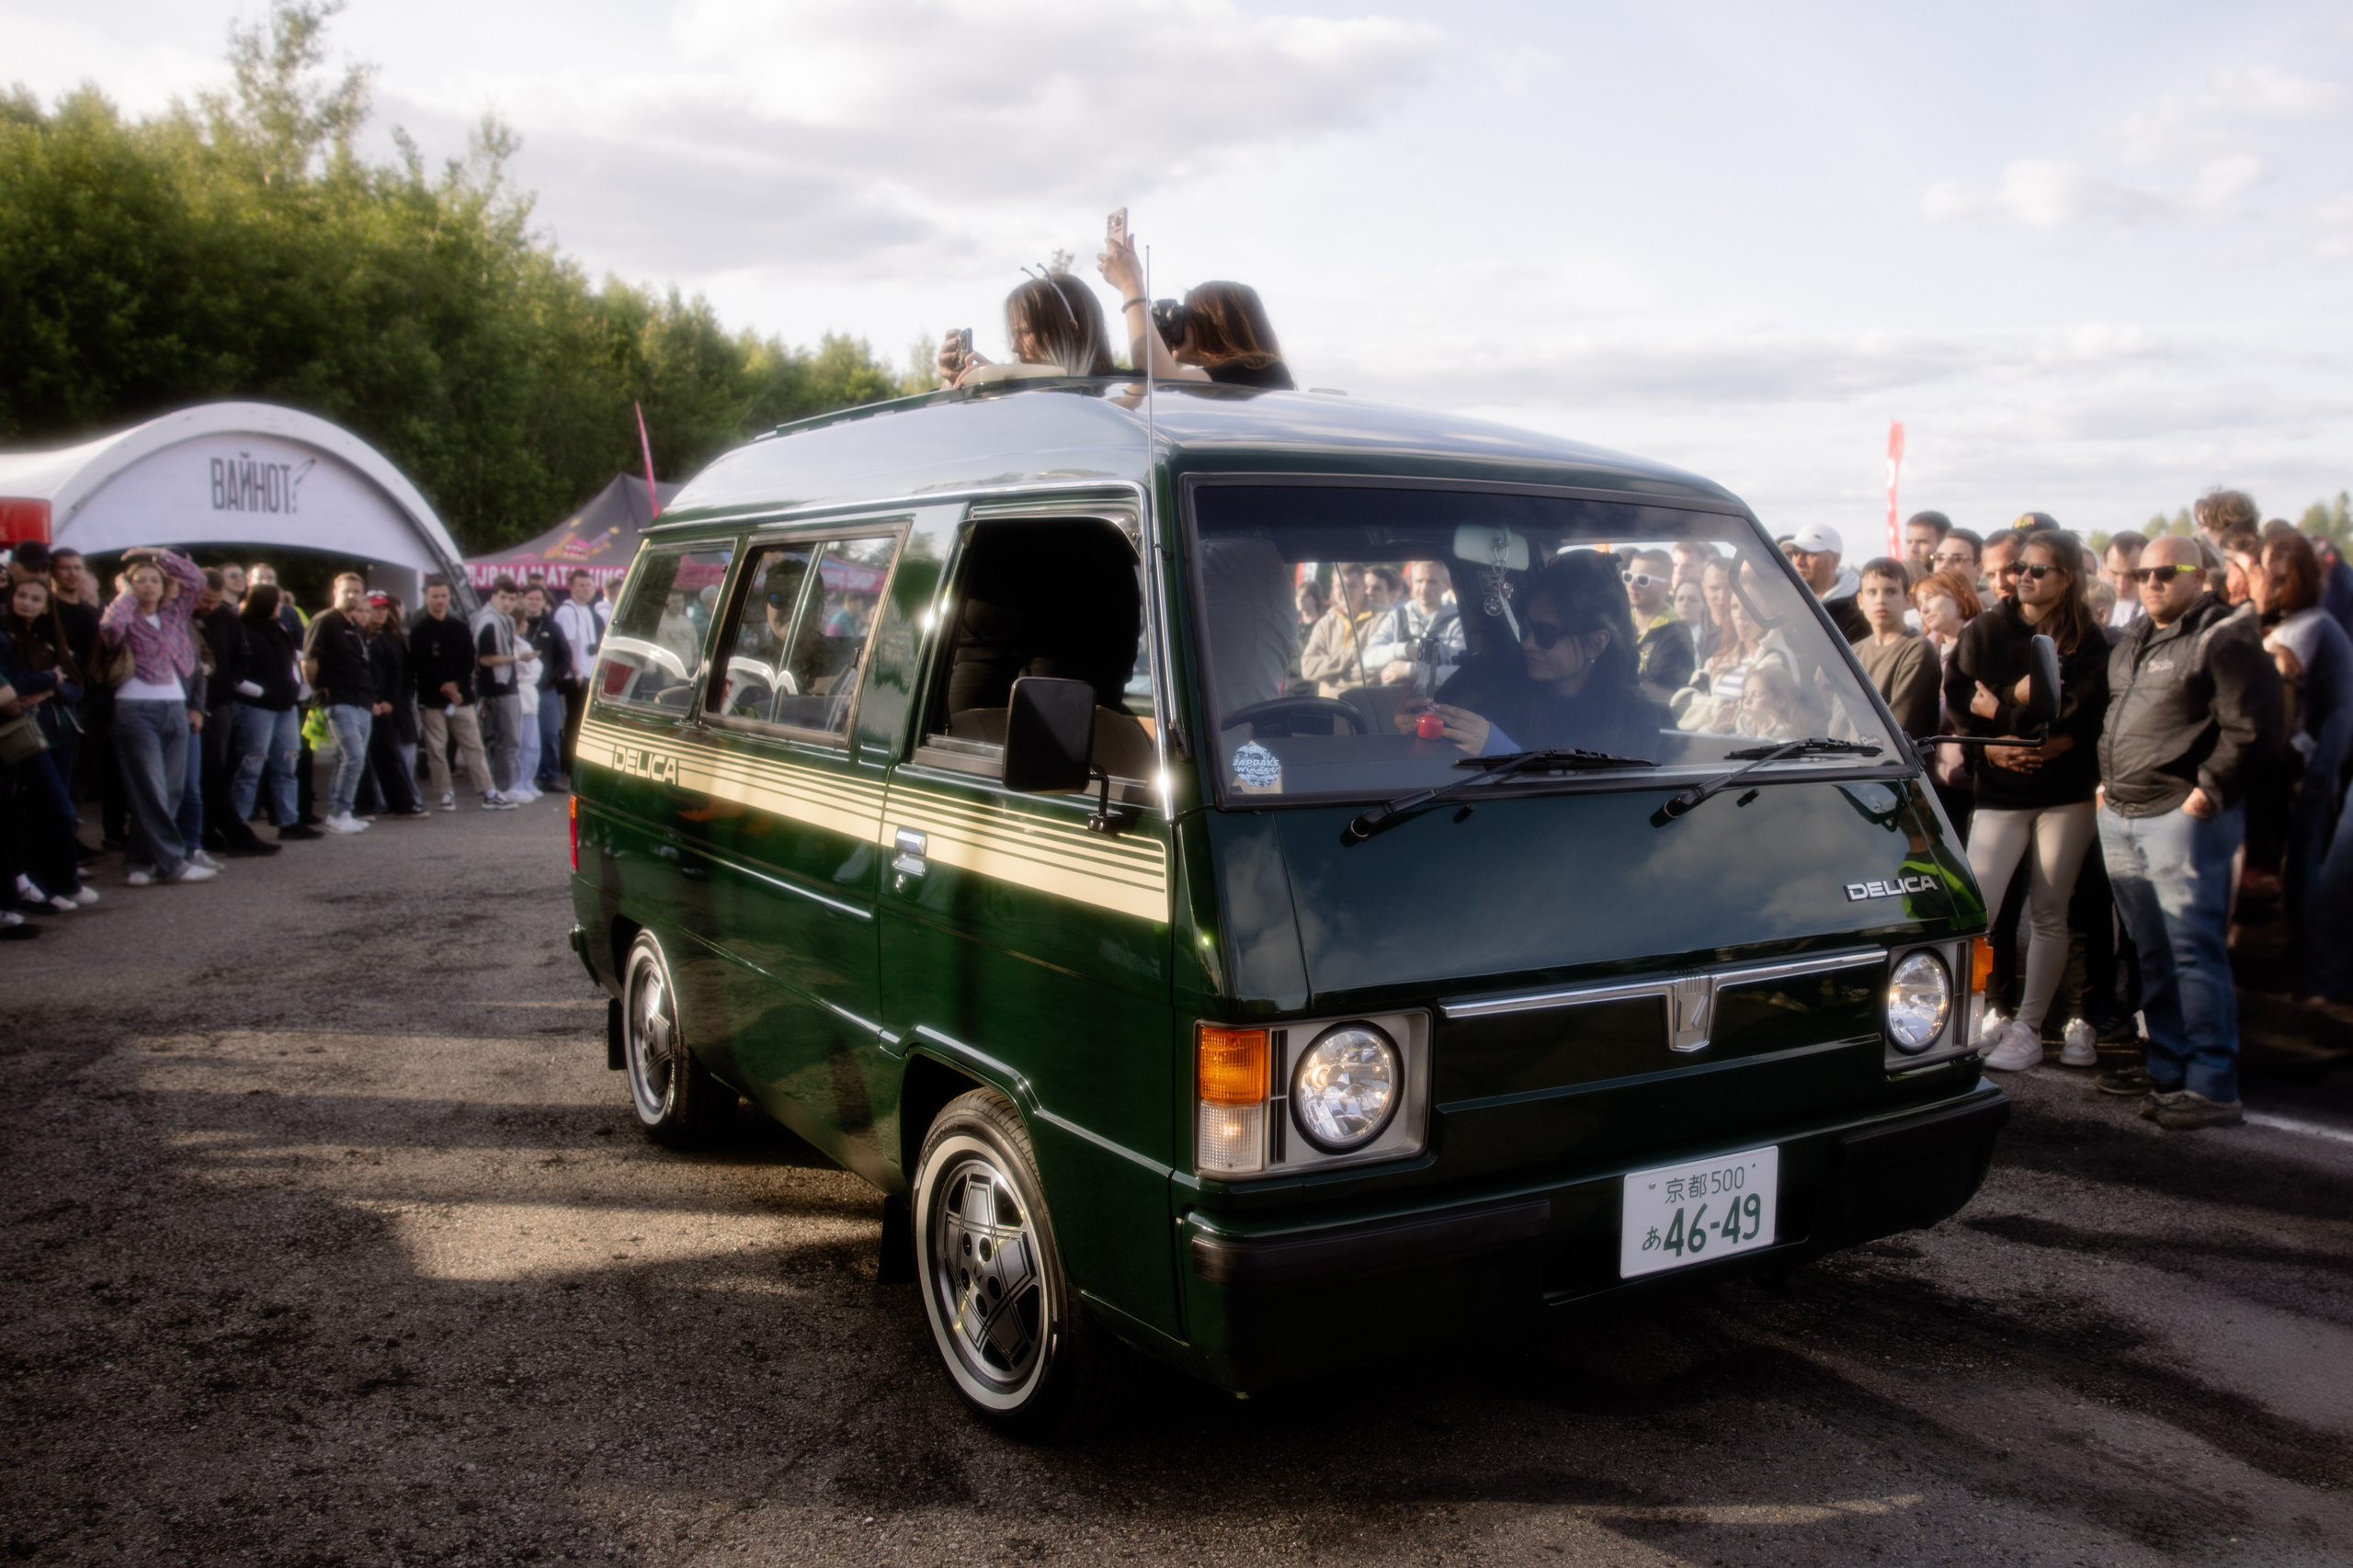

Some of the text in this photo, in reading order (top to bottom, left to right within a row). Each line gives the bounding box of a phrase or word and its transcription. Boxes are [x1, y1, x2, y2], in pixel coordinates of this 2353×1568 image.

[613, 744, 676, 786] DELICA
[1232, 758, 1279, 767] JAPDAYS
[1844, 875, 1938, 902] DELICA
[1643, 1193, 1761, 1257] あ 46-49
